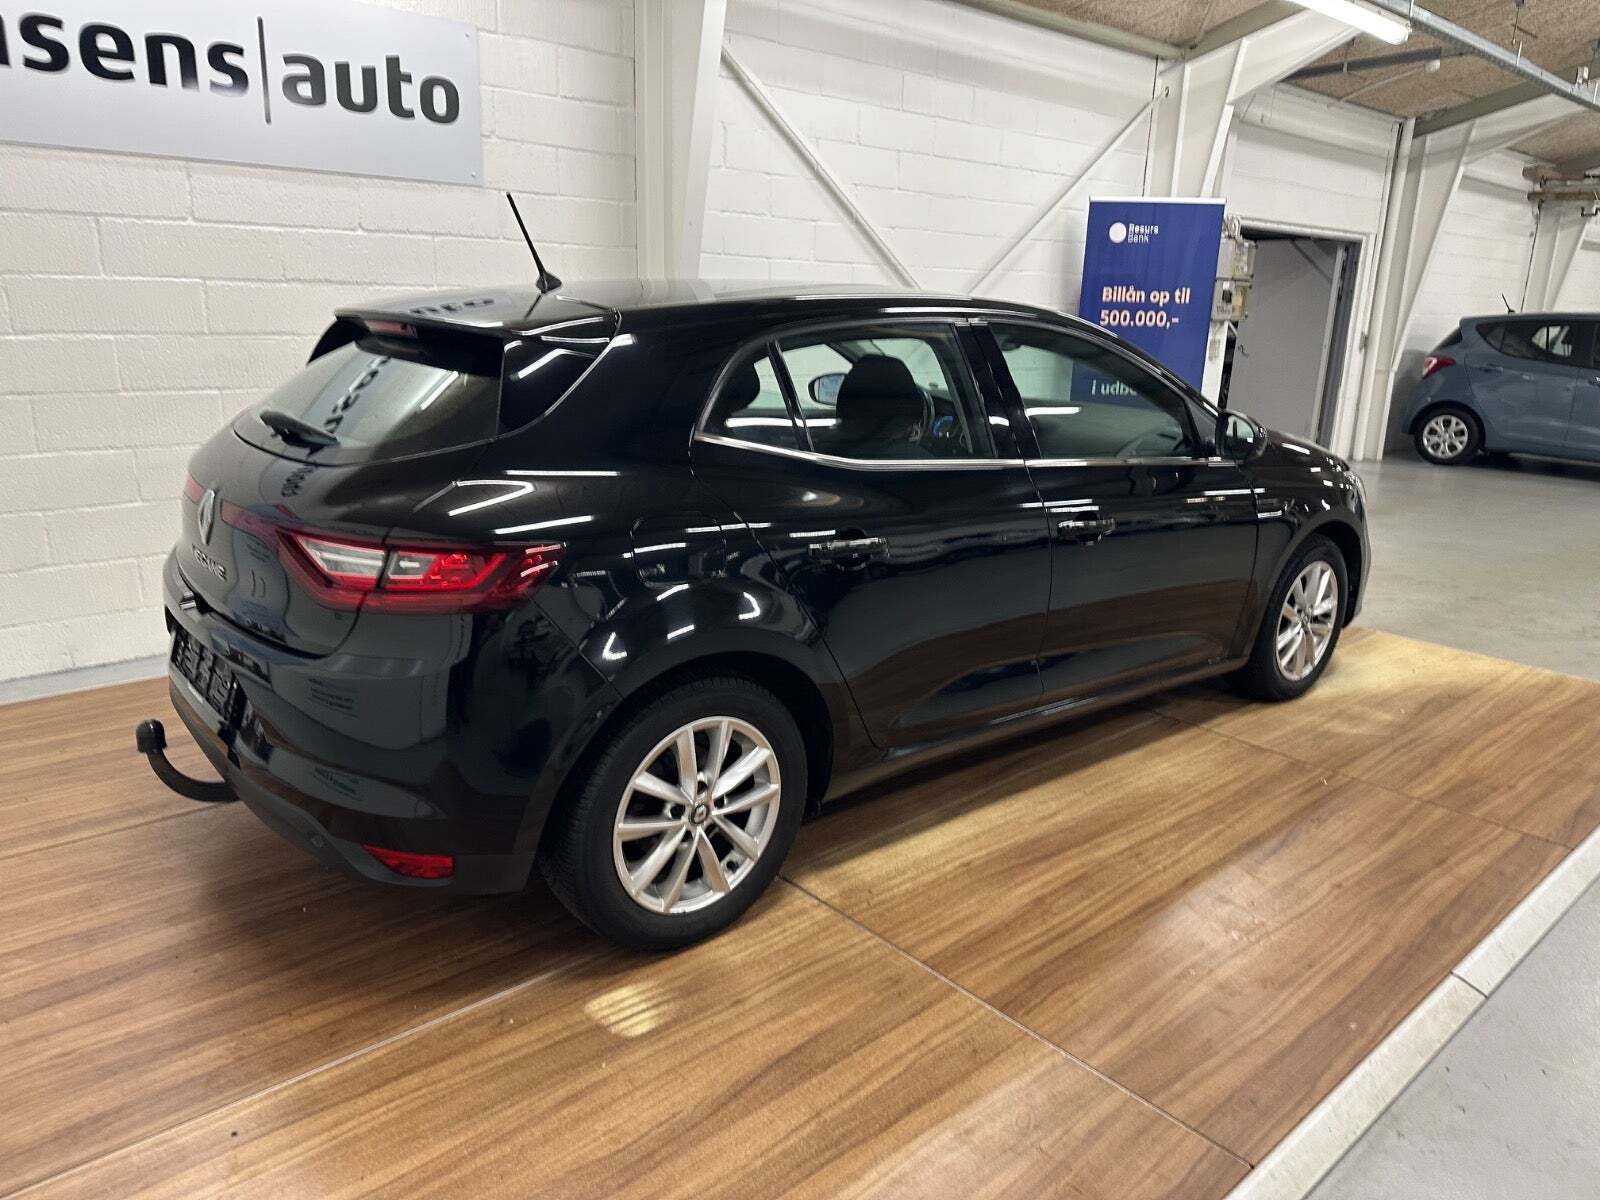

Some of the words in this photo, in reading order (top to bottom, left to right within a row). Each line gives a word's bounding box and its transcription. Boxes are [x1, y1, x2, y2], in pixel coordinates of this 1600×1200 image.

[0, 12, 247, 95] sens
[282, 54, 460, 124] auto
[1128, 234, 1149, 243] Bank
[1102, 286, 1145, 304] Billån
[1149, 291, 1170, 306] op
[1174, 288, 1191, 305] til
[1100, 310, 1179, 330] 500.000,-
